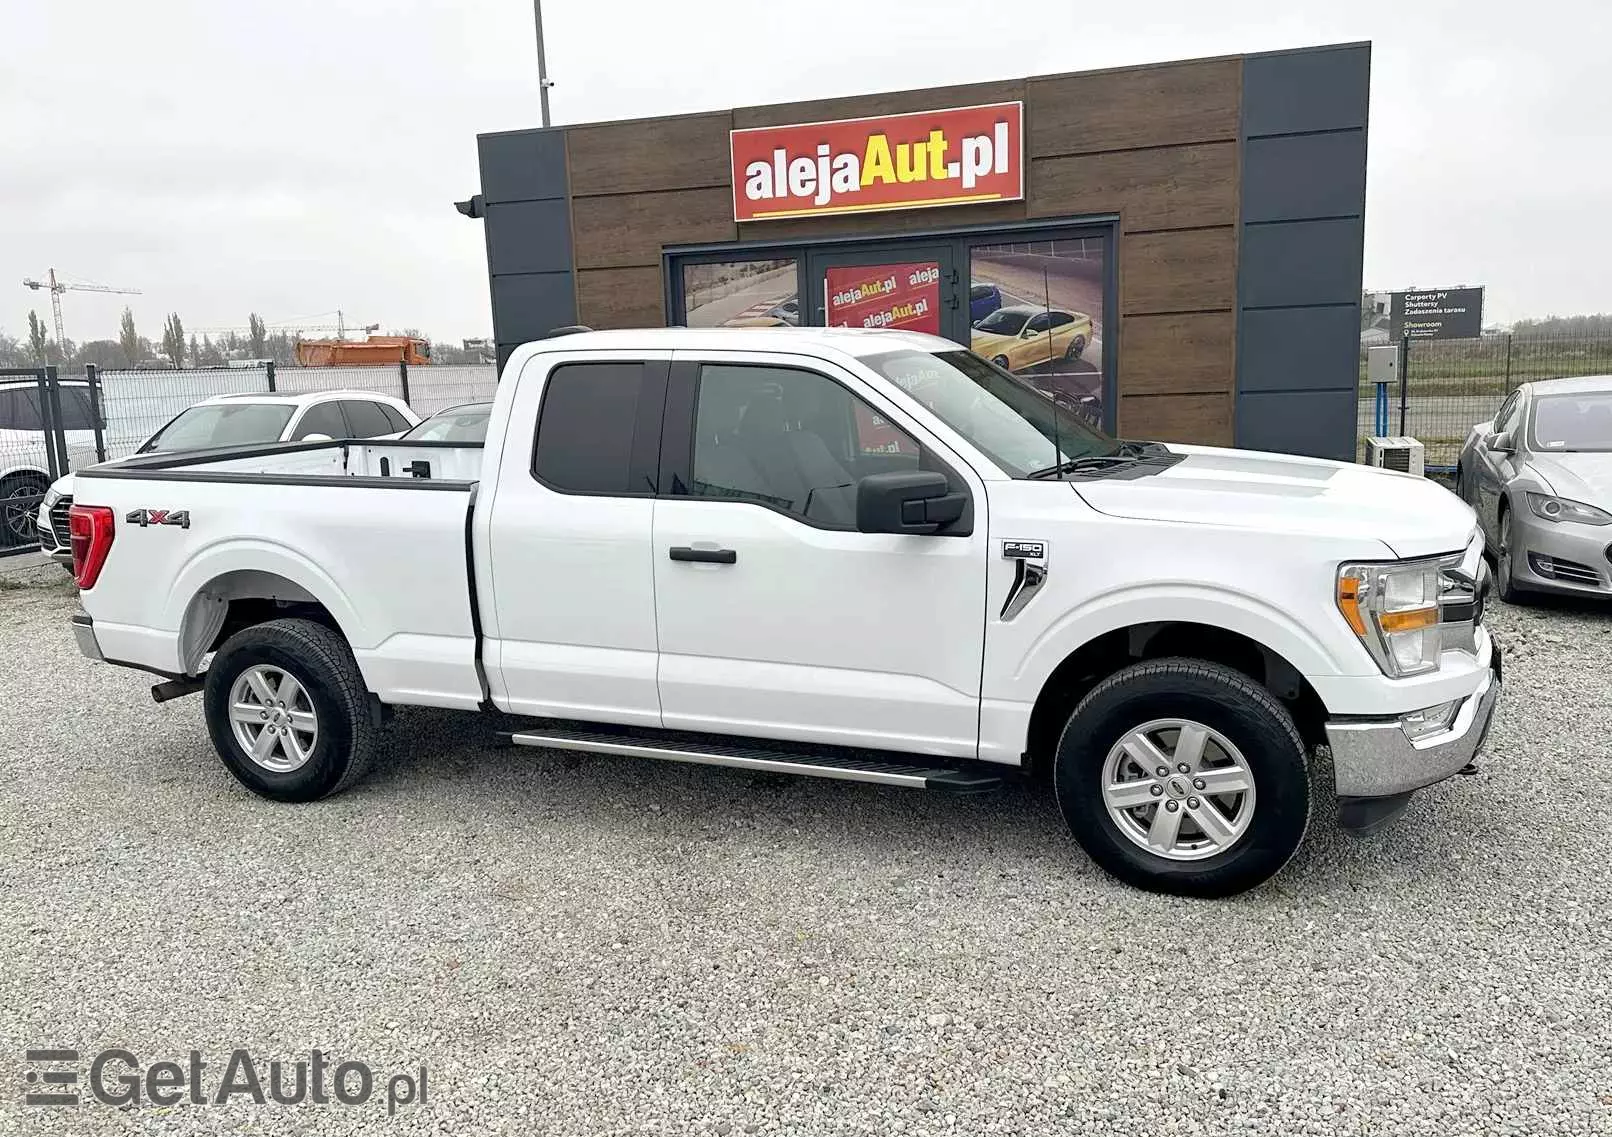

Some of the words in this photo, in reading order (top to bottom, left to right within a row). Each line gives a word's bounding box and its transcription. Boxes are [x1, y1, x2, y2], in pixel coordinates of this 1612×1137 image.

[745, 121, 1009, 206] alejaAut.pl
[908, 266, 940, 286] aleja
[832, 275, 897, 306] alejaAut.pl
[1404, 293, 1437, 302] Carporty
[1437, 292, 1448, 300] PV
[863, 298, 929, 328] alejaAut.pl
[1404, 307, 1443, 315] Zadaszenia
[1443, 306, 1466, 314] tarasu
[1403, 321, 1442, 329] Showroom
[1004, 543, 1043, 551] F-150
